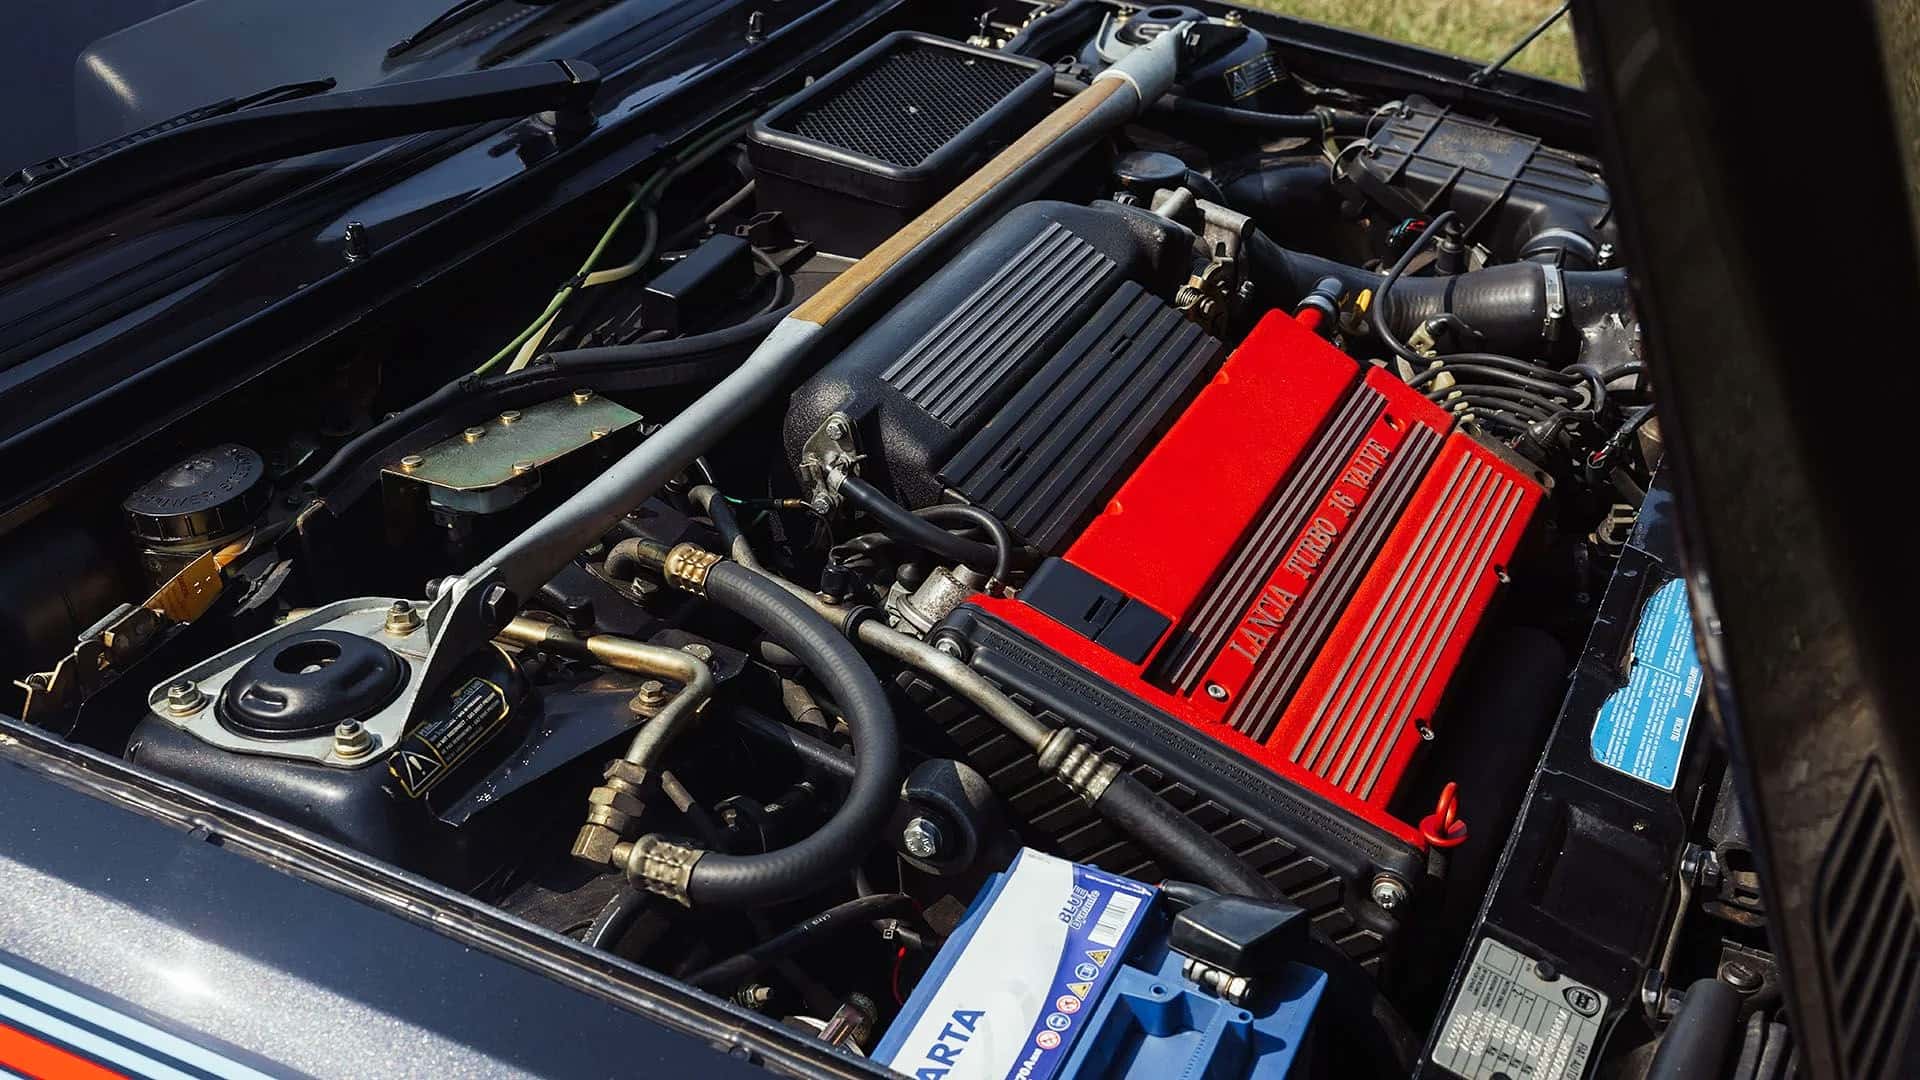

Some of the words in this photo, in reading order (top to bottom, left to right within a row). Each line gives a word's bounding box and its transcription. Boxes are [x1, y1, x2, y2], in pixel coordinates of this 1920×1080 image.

[1342, 438, 1390, 490] VALVE
[1329, 491, 1356, 517] 16
[1286, 517, 1337, 580] TURBO
[1229, 585, 1298, 664] LANCIA
[1058, 884, 1088, 924] BLUE
